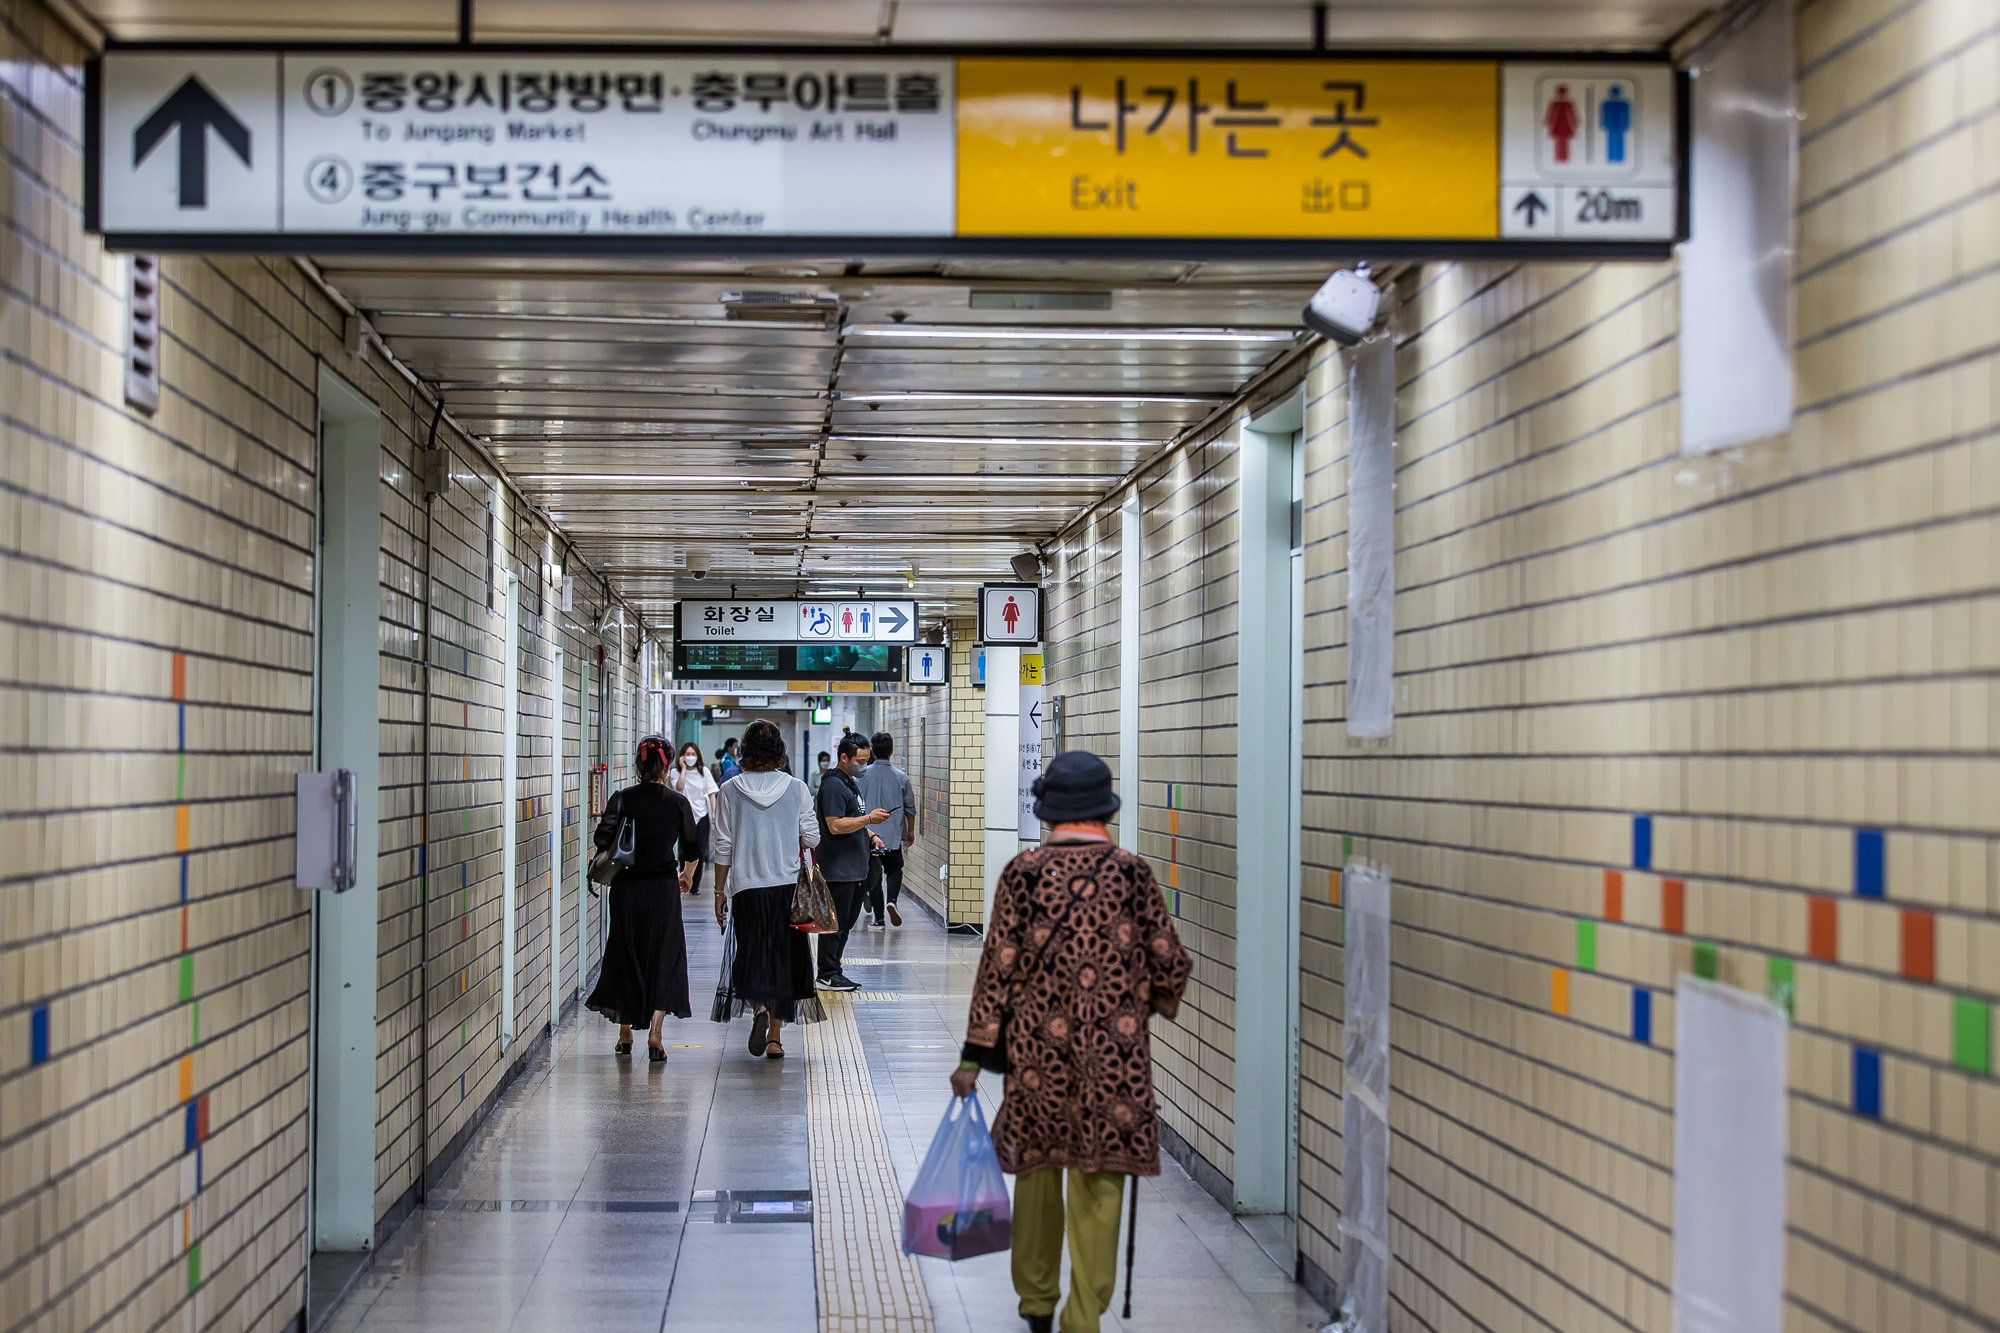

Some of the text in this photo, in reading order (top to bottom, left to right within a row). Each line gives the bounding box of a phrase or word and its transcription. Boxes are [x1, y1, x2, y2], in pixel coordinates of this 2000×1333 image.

[1071, 76, 1379, 158] 나가는 곳
[362, 120, 586, 144] To Jungang Market
[692, 120, 898, 144] Chungmu Art Hall
[362, 162, 613, 201] 중구보건소
[1070, 174, 1139, 211] Exit
[1301, 178, 1370, 214] 出口
[1577, 190, 1643, 222] 20m
[463, 208, 591, 231] Community
[601, 208, 676, 226] Health
[688, 208, 765, 227] Center
[703, 606, 775, 623] 화장실
[703, 625, 735, 636] Toilet
[1020, 662, 1038, 679] 가는
